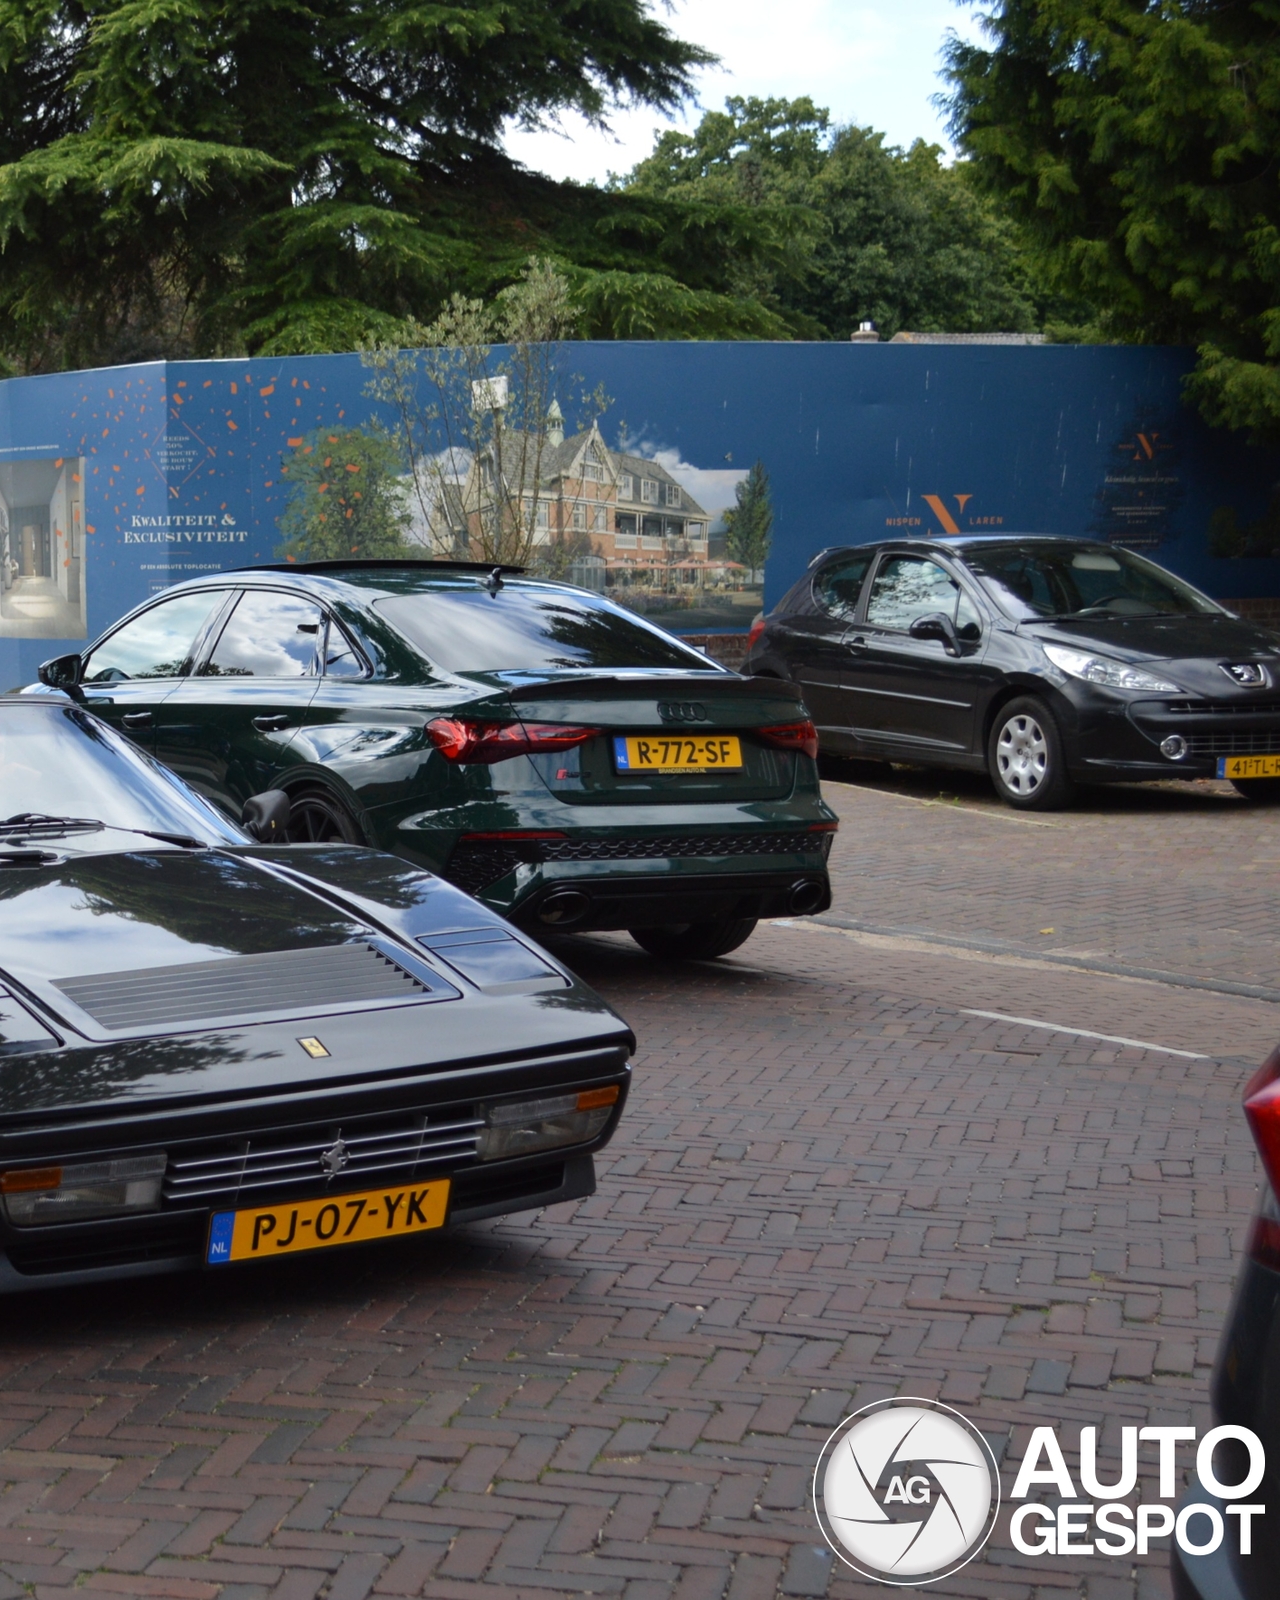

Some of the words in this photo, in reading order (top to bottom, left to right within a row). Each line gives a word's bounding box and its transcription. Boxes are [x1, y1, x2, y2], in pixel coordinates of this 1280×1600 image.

[132, 515, 216, 527] KWALITEIT
[221, 513, 236, 526] &
[886, 518, 921, 526] NISPEN
[969, 517, 1003, 525] LAREN
[124, 531, 248, 543] EXCLUSIVITEIT
[637, 740, 730, 764] R-772-SF
[251, 1189, 430, 1251] PJ-07-YK
[211, 1242, 227, 1254] NL
